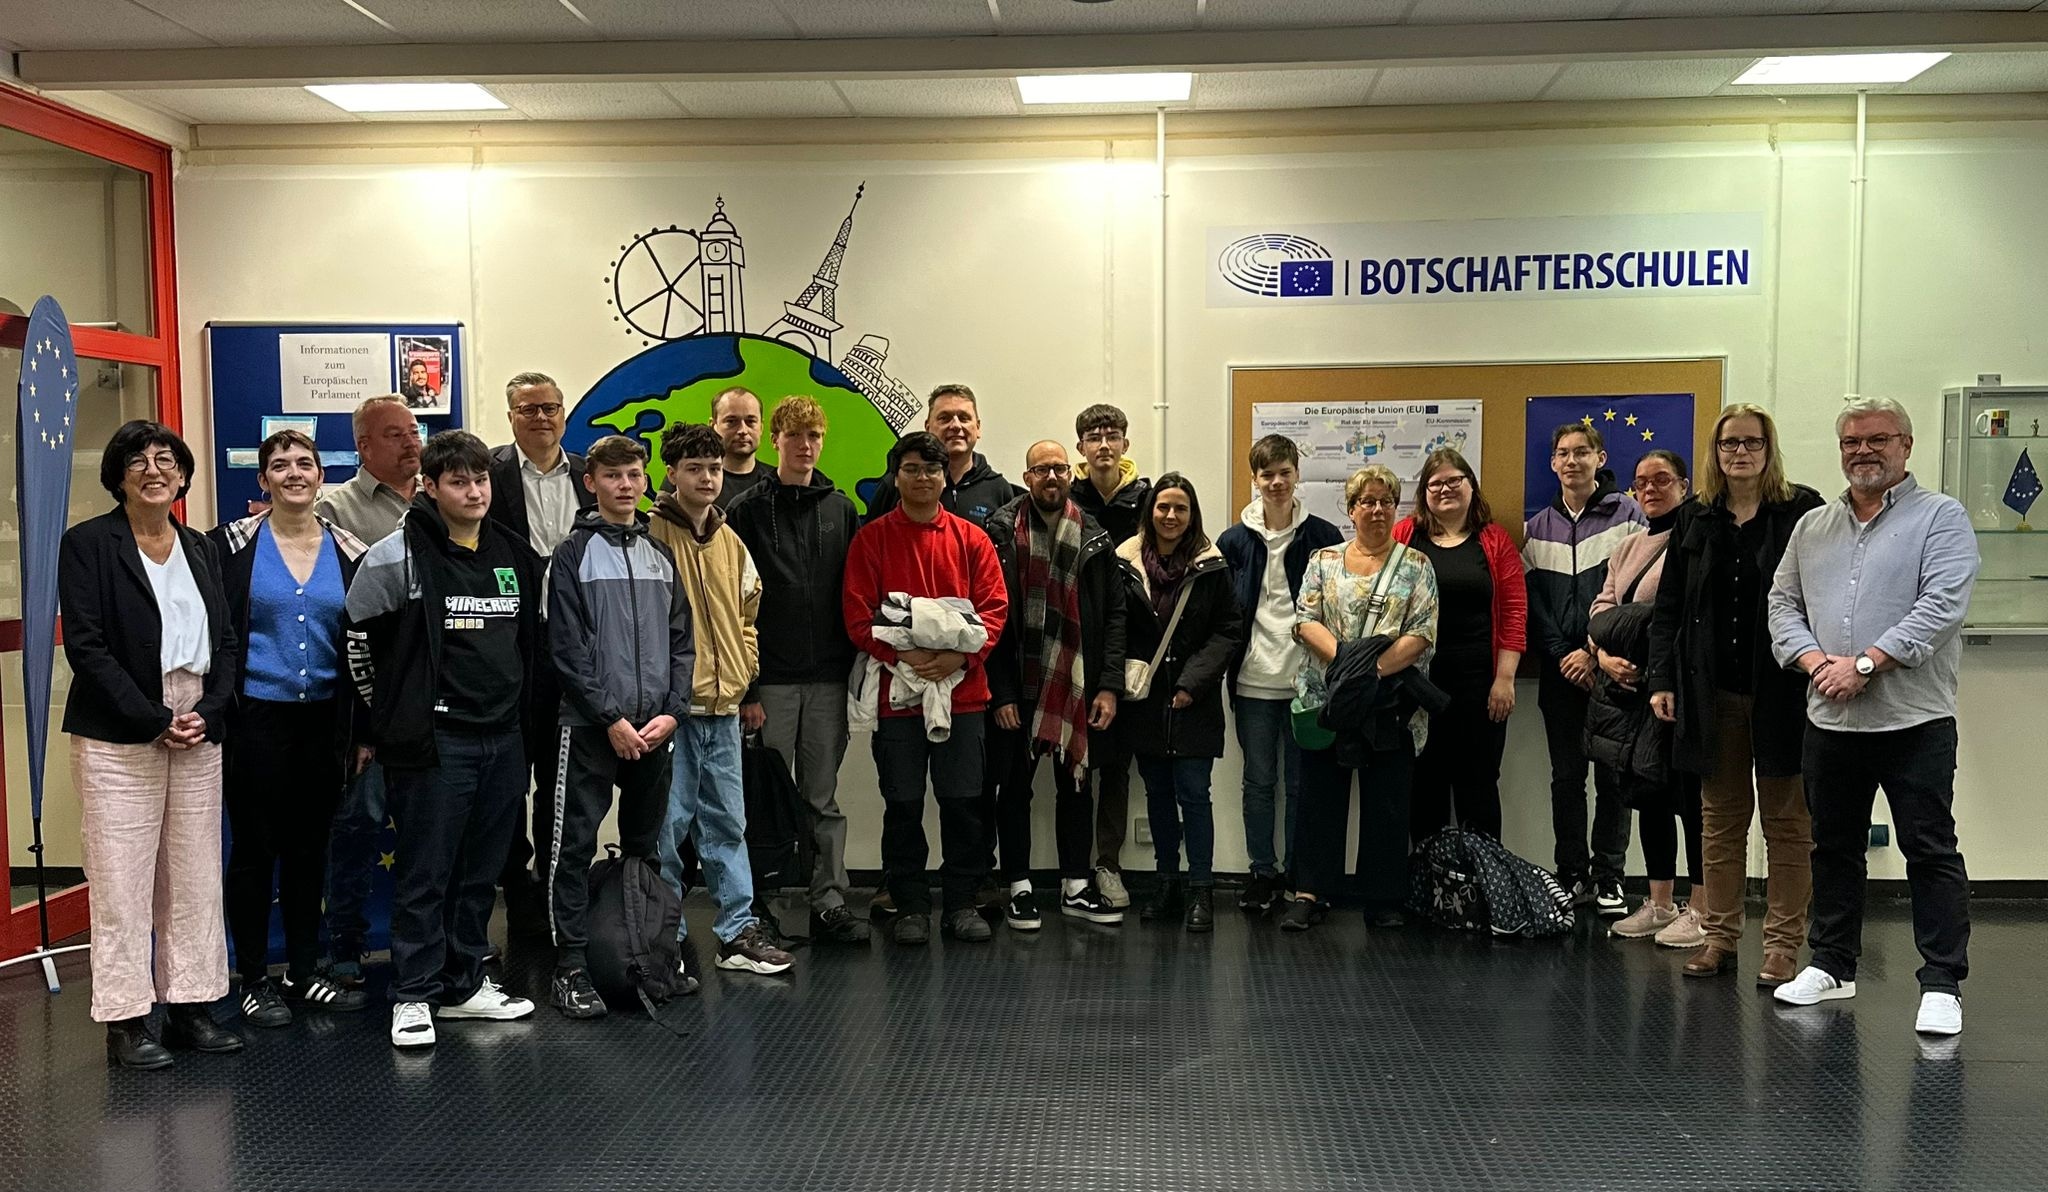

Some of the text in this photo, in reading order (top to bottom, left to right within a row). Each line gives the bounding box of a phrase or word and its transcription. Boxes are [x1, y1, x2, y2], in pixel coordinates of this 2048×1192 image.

[1360, 248, 1750, 296] BOTSCHAFTERSCHULEN
[300, 344, 369, 355] Informationen
[324, 362, 346, 370] zum
[302, 375, 369, 386] Europäischen
[310, 389, 361, 399] Parlament
[1304, 405, 1425, 416] Die Europäische Union (EU)
[445, 596, 520, 617] MINECRAF
